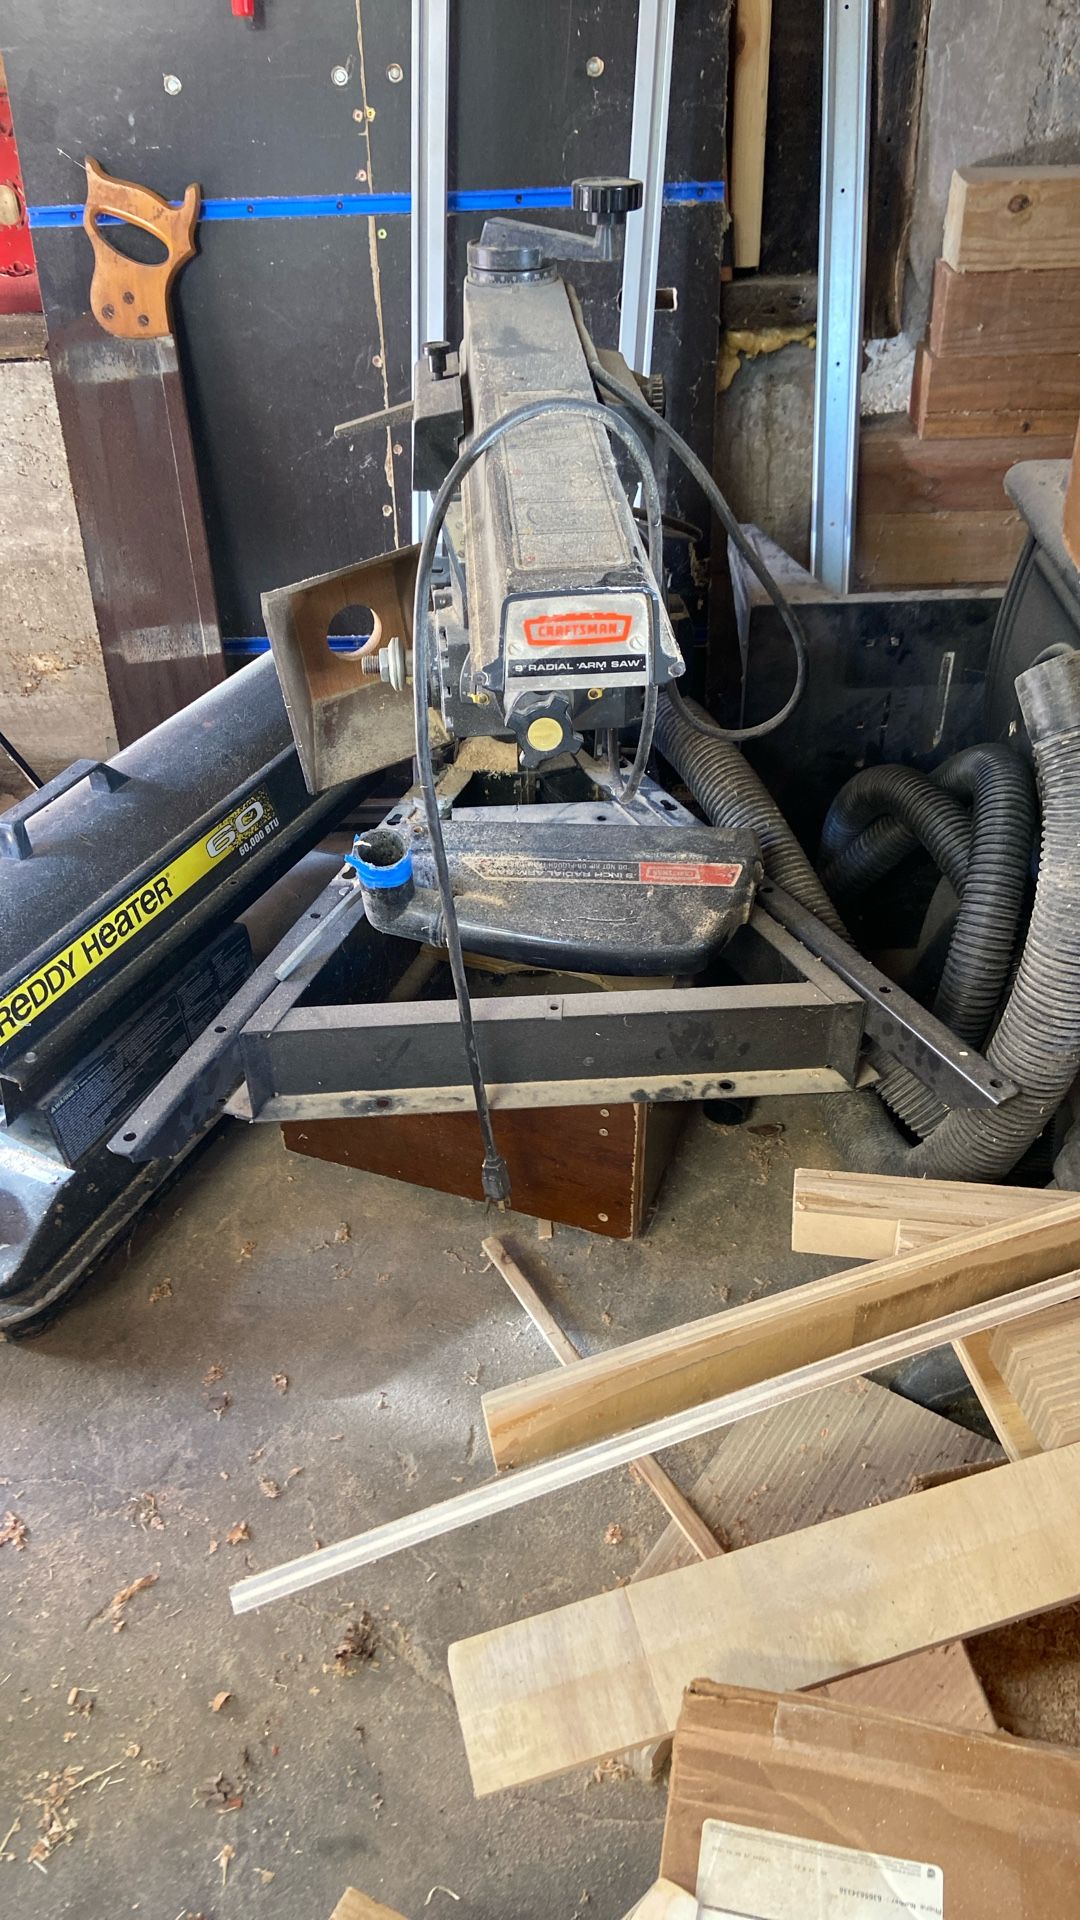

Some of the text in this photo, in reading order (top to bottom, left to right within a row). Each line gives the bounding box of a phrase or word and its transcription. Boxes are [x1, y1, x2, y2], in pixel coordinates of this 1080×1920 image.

[537, 623, 618, 637] CRAFTSMAN
[528, 662, 574, 672] RADIAL
[577, 661, 607, 670] ARM
[610, 658, 640, 668] SAW
[206, 801, 264, 858] 60
[238, 816, 280, 857] 60,000 BTU
[546, 869, 591, 878] RADIAL
[594, 871, 623, 879] INCH
